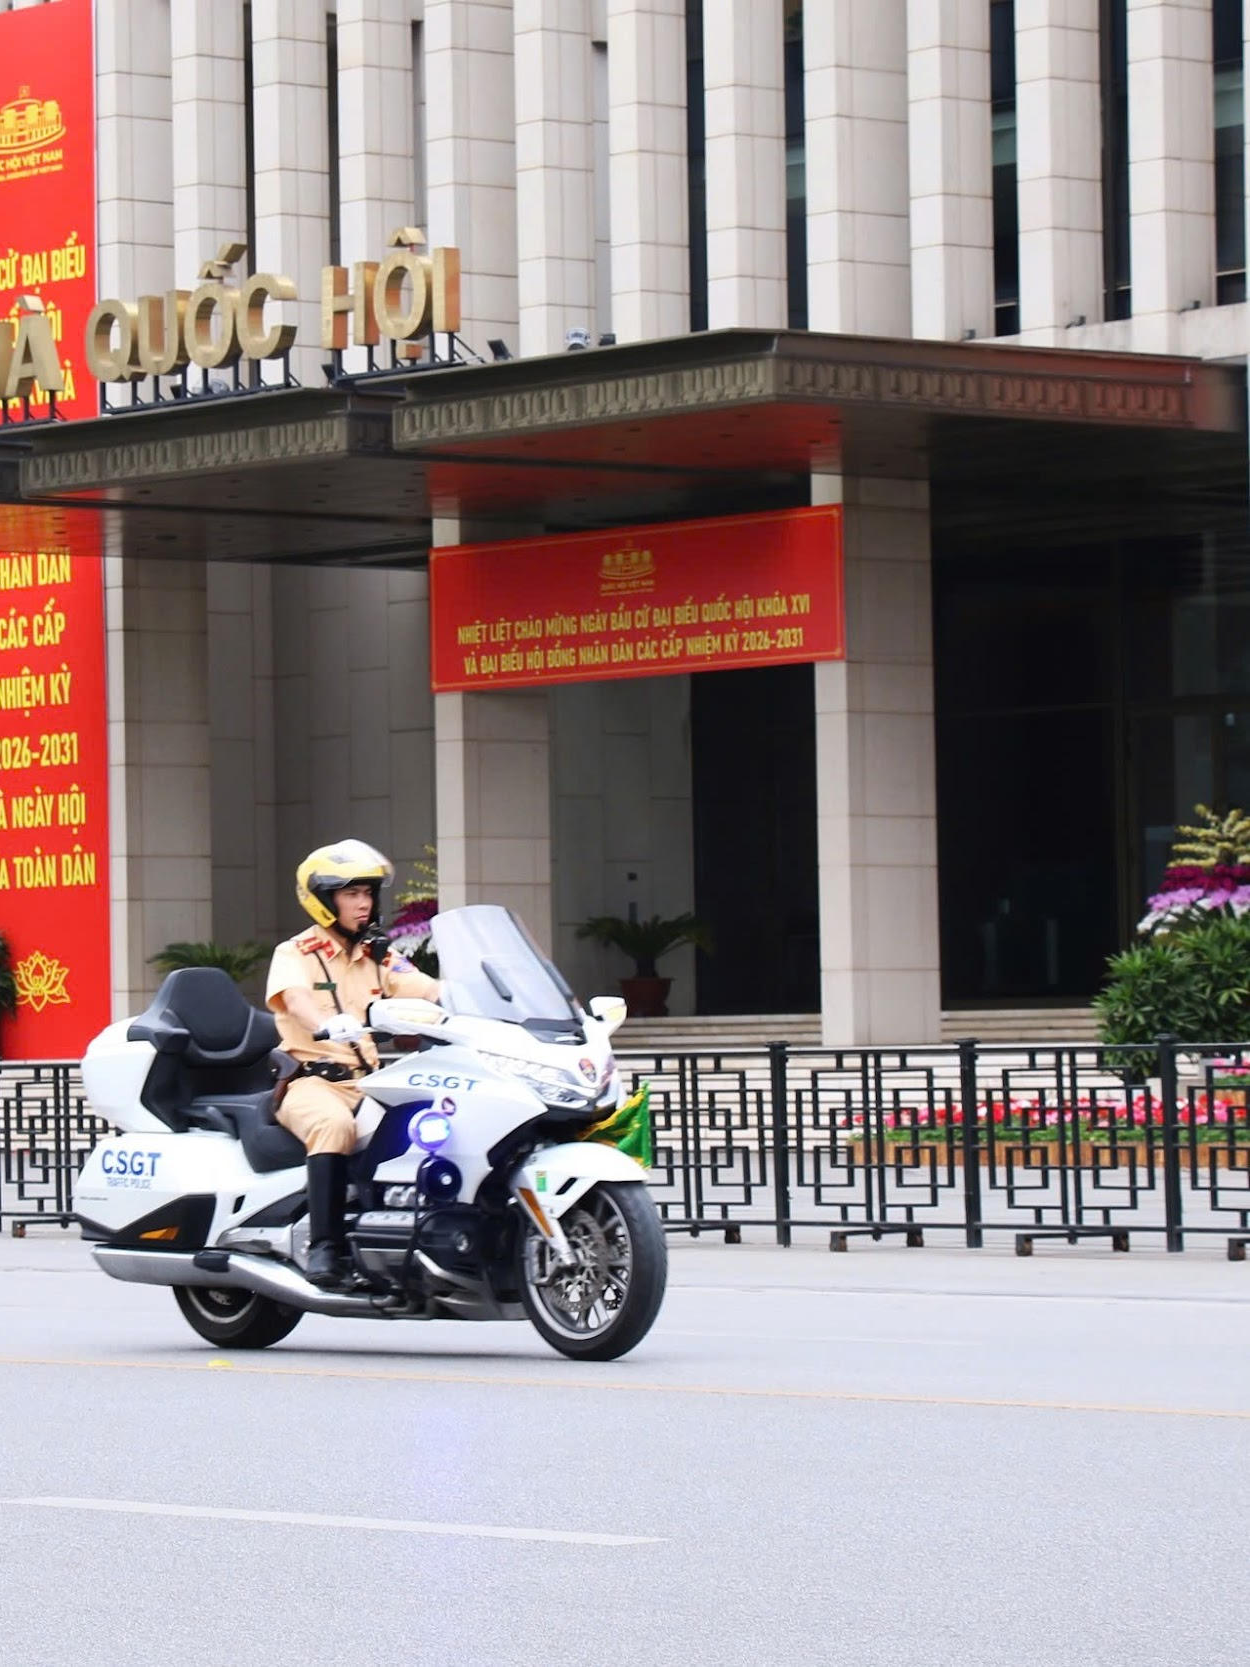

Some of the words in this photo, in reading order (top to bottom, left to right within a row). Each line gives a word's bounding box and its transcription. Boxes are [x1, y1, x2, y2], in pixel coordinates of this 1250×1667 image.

[21, 251, 48, 294] ĐẠI
[50, 231, 86, 282] BIỂU
[86, 243, 297, 383] QUỐC
[321, 227, 461, 360] HỘI
[33, 598, 65, 647] CẤP
[458, 620, 487, 649] NHIỆT
[490, 617, 511, 646] LIỆT
[515, 615, 542, 640] CHÀO
[545, 612, 577, 637] MỪNG
[581, 609, 607, 633] NGÀY
[611, 602, 632, 630] BẦU
[634, 603, 649, 628] CỬ
[653, 607, 671, 632] ĐẠI
[674, 596, 698, 625] BIỂU
[702, 593, 732, 622] QUỐC
[734, 594, 754, 625] HỘI
[757, 590, 787, 617] KHÓA
[791, 594, 810, 615] XVI
[464, 651, 478, 675] VÀ
[480, 655, 498, 679] ĐẠI
[501, 644, 524, 673] BIỂU
[526, 645, 544, 675] HỘI
[547, 640, 576, 668] ĐỒNG
[579, 640, 608, 665] NHÂN
[611, 637, 634, 662] DÂN
[636, 636, 659, 660] CÁC
[661, 629, 683, 659] CẤP
[686, 630, 721, 661] NHIỆM
[724, 627, 739, 653] KỲ
[742, 627, 803, 651] 2026-2031
[50, 662, 71, 705] KỲ
[12, 786, 54, 830] NGÀY
[58, 784, 86, 834] HỘI
[13, 846, 57, 888] TOÀN
[62, 844, 95, 885] DÂN
[408, 1073, 481, 1091] CSGT
